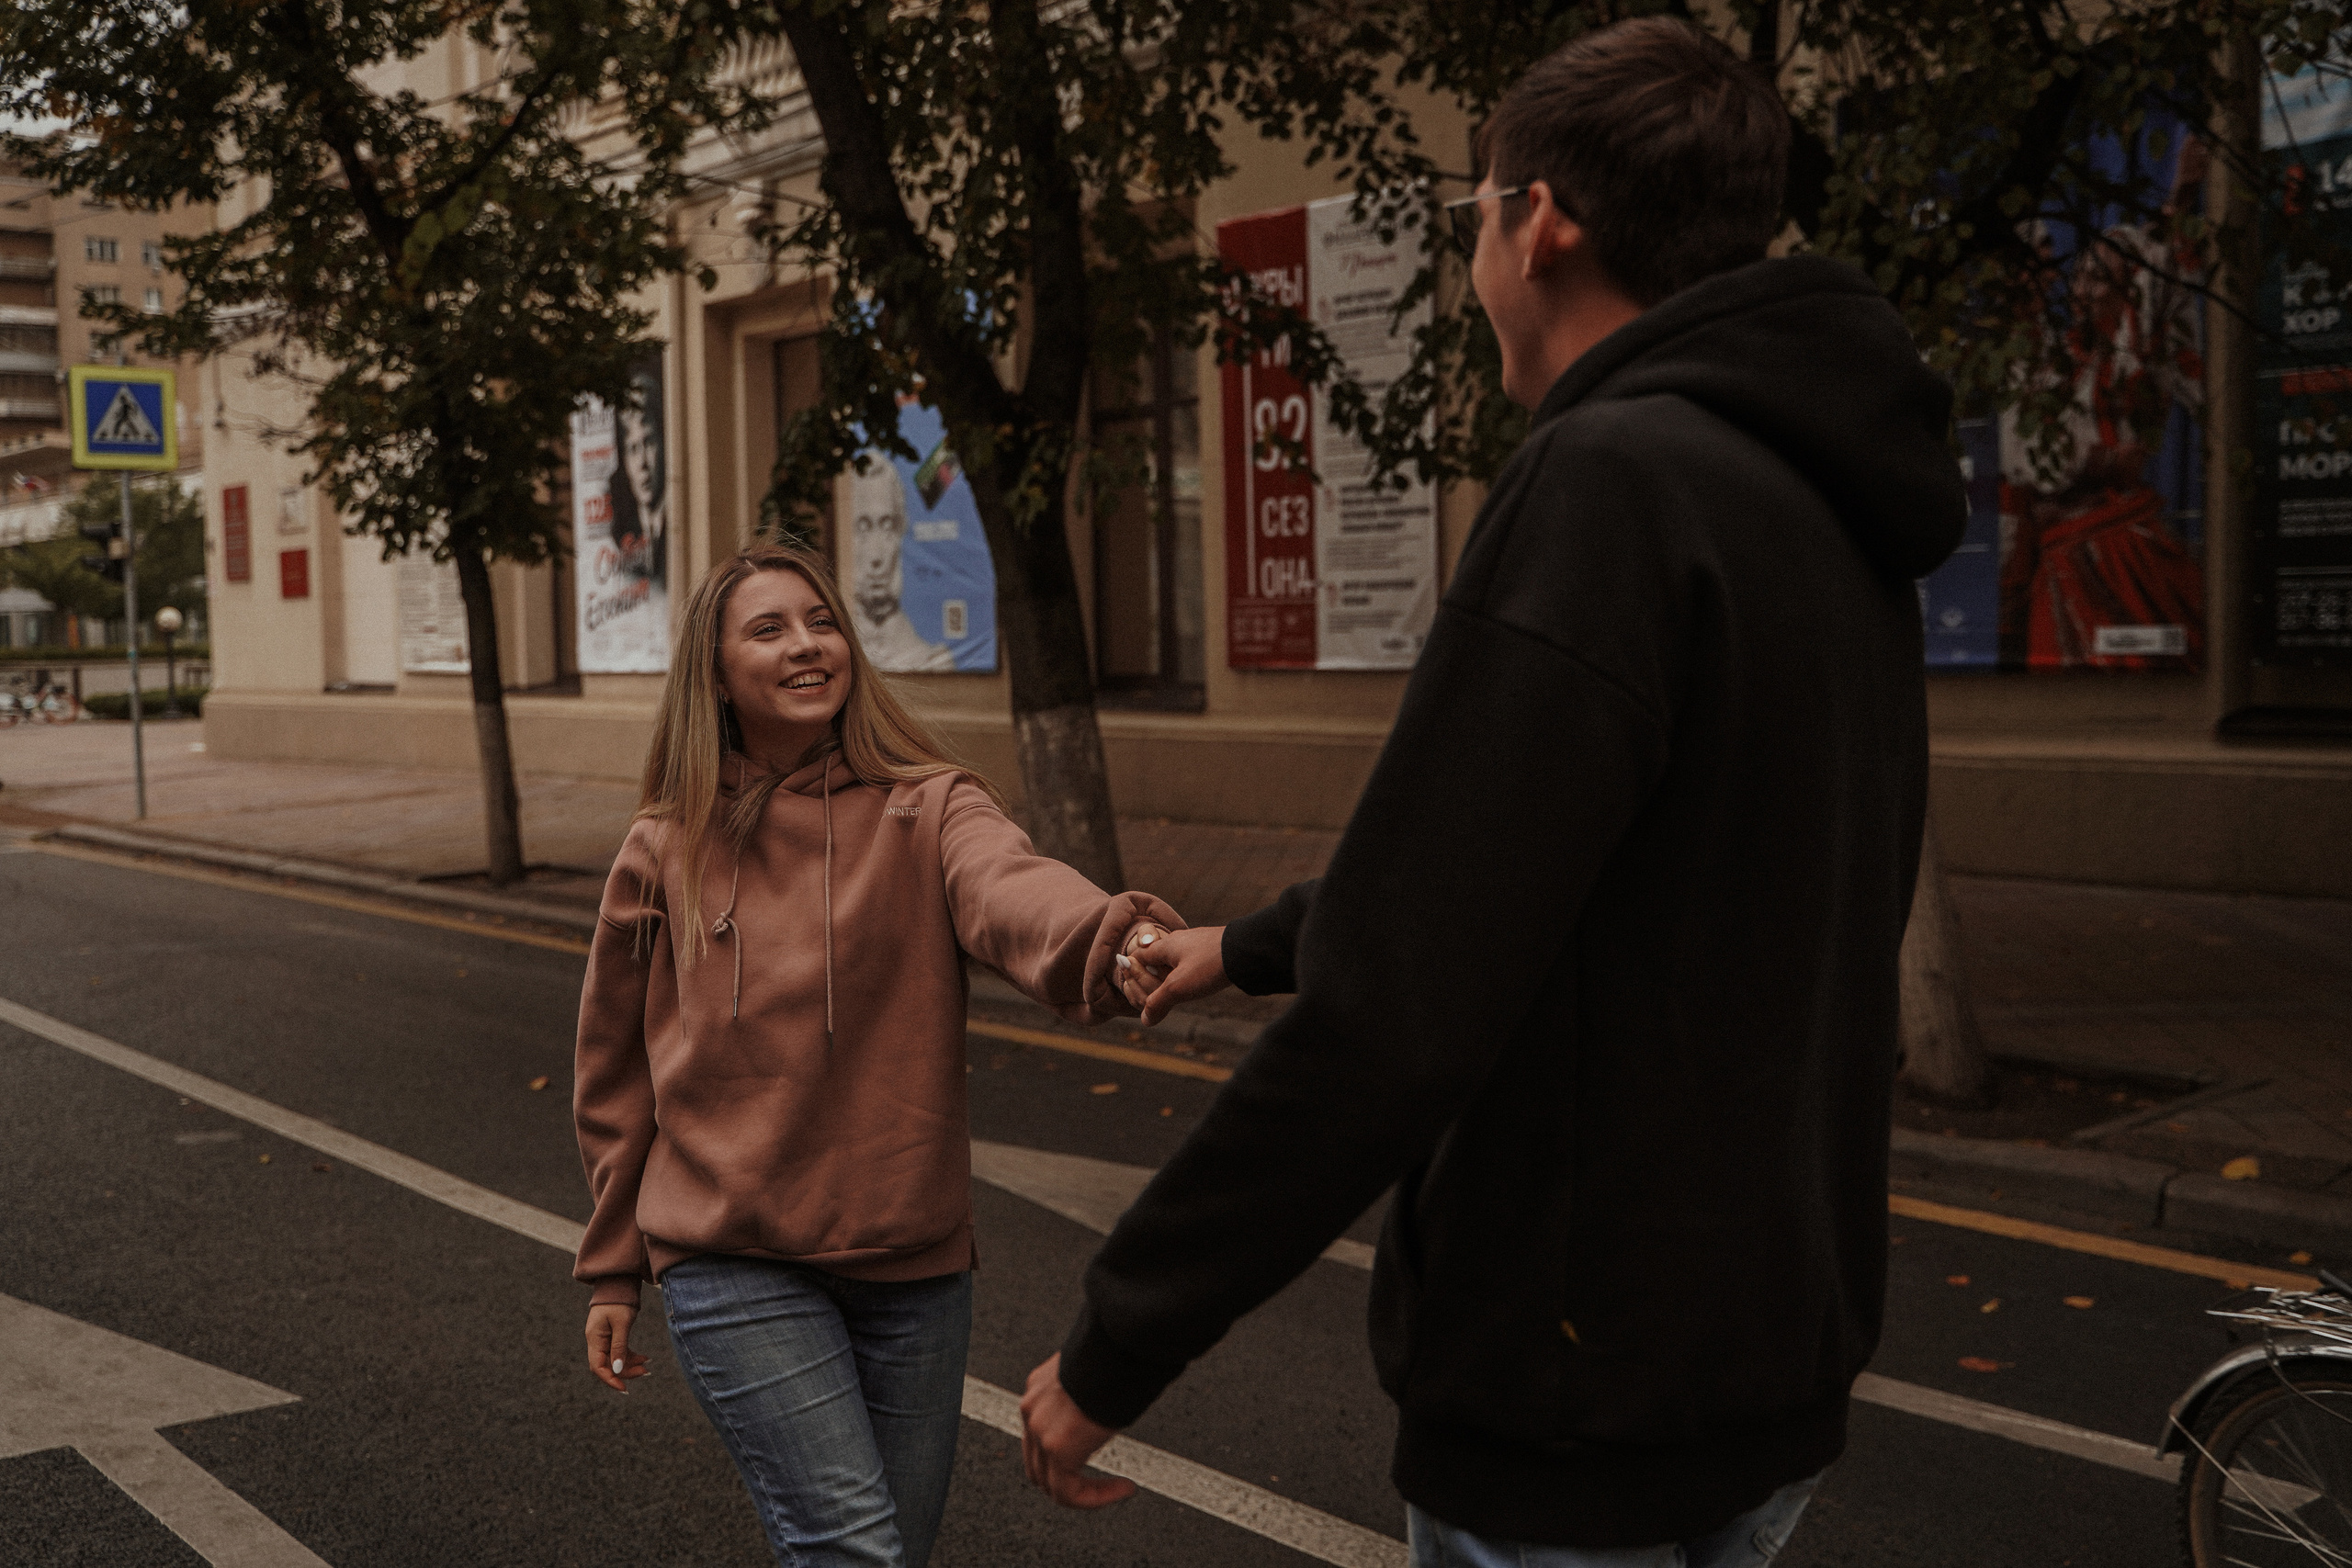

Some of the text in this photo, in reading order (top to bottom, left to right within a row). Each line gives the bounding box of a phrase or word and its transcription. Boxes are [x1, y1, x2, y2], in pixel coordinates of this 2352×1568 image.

[1254, 393, 1307, 471] 92
[1261, 493, 1310, 538] СЕЗ
[1260, 555, 1314, 599] ОНА
[886, 807, 922, 817] WINTER
